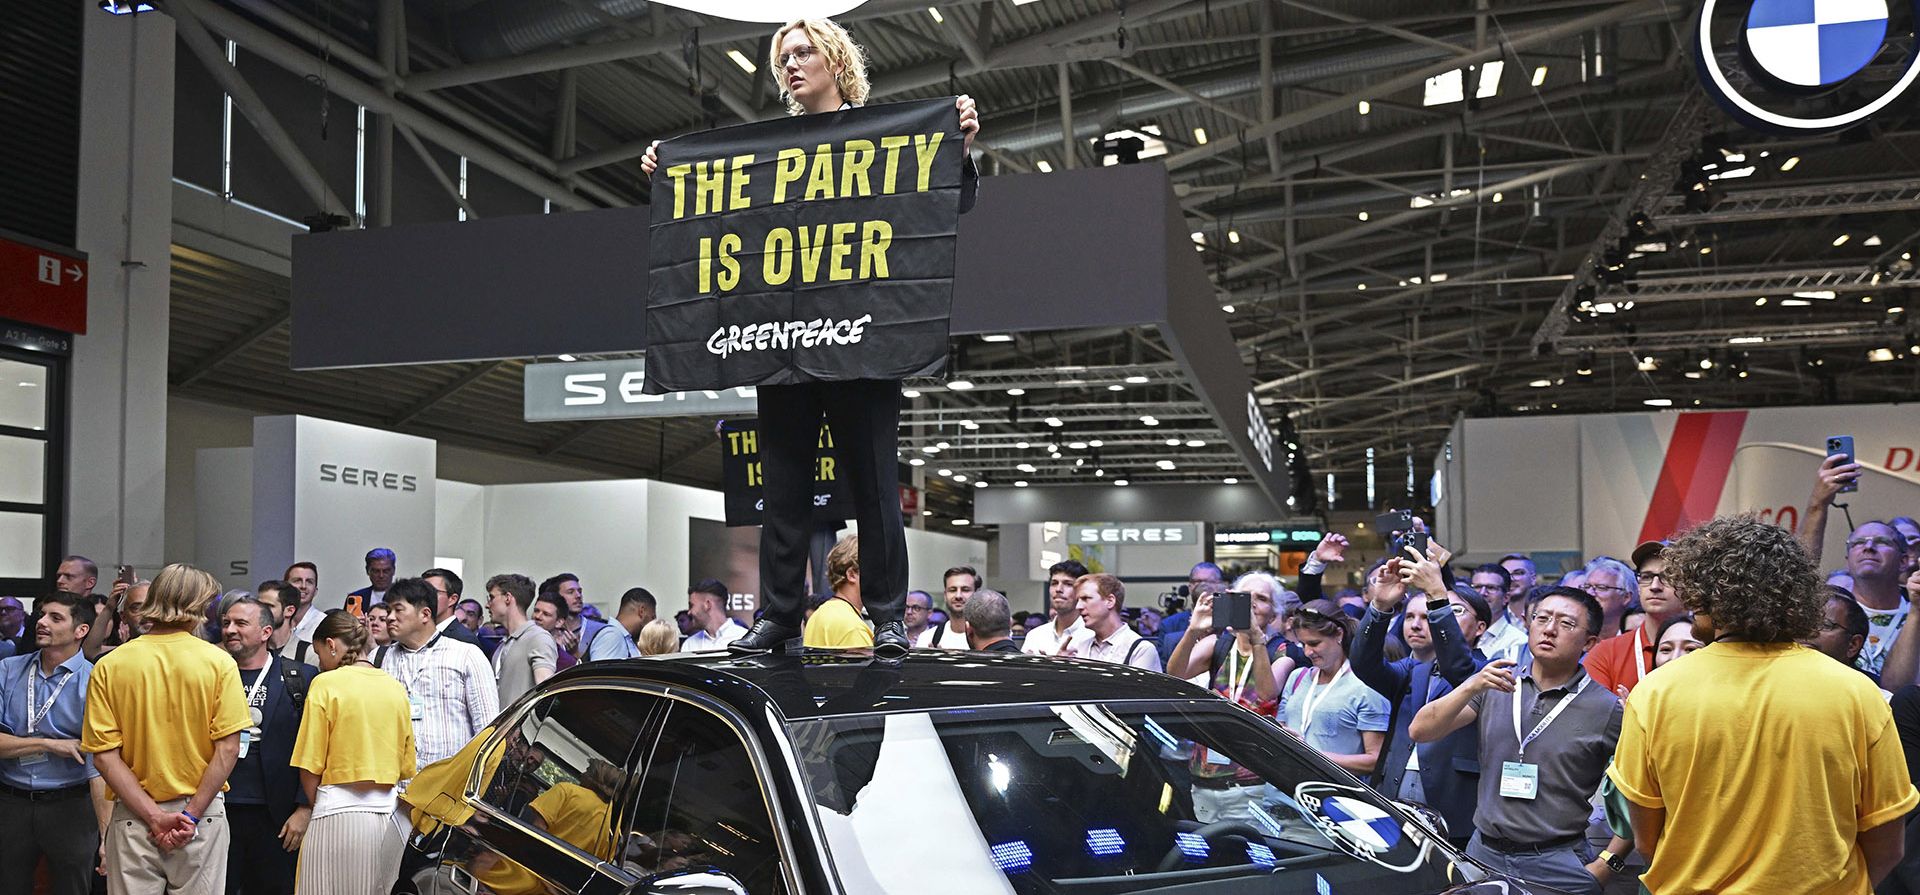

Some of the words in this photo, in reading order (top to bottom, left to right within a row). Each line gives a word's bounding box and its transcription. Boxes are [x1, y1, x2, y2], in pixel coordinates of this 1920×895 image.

[666, 154, 755, 220] THE
[772, 131, 945, 204] PARTY
[698, 232, 742, 294] IS
[762, 219, 894, 286] OVER
[61, 340, 69, 351] 3
[706, 313, 873, 360] GREENPEACE
[564, 370, 758, 406] SE
[728, 430, 758, 456] TH
[320, 463, 417, 492] SERES
[1080, 528, 1183, 542] SERES
